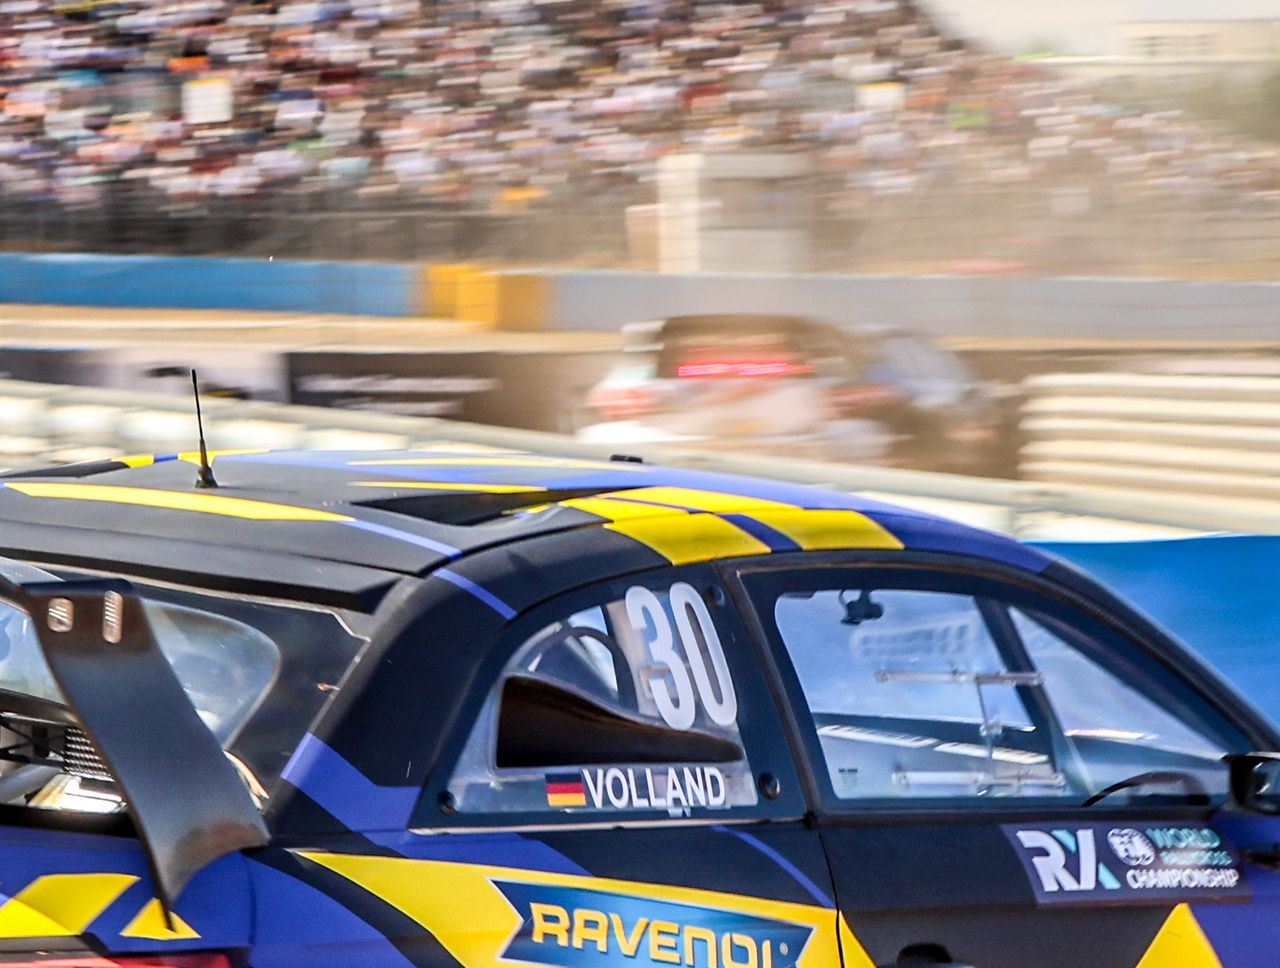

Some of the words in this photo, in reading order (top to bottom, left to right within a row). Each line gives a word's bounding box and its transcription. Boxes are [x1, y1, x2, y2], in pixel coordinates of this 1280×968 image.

[625, 581, 738, 730] 30
[582, 767, 726, 809] VOLLAND
[1145, 828, 1221, 849] WORLD
[1126, 868, 1240, 890] CHAMPIONSHIP
